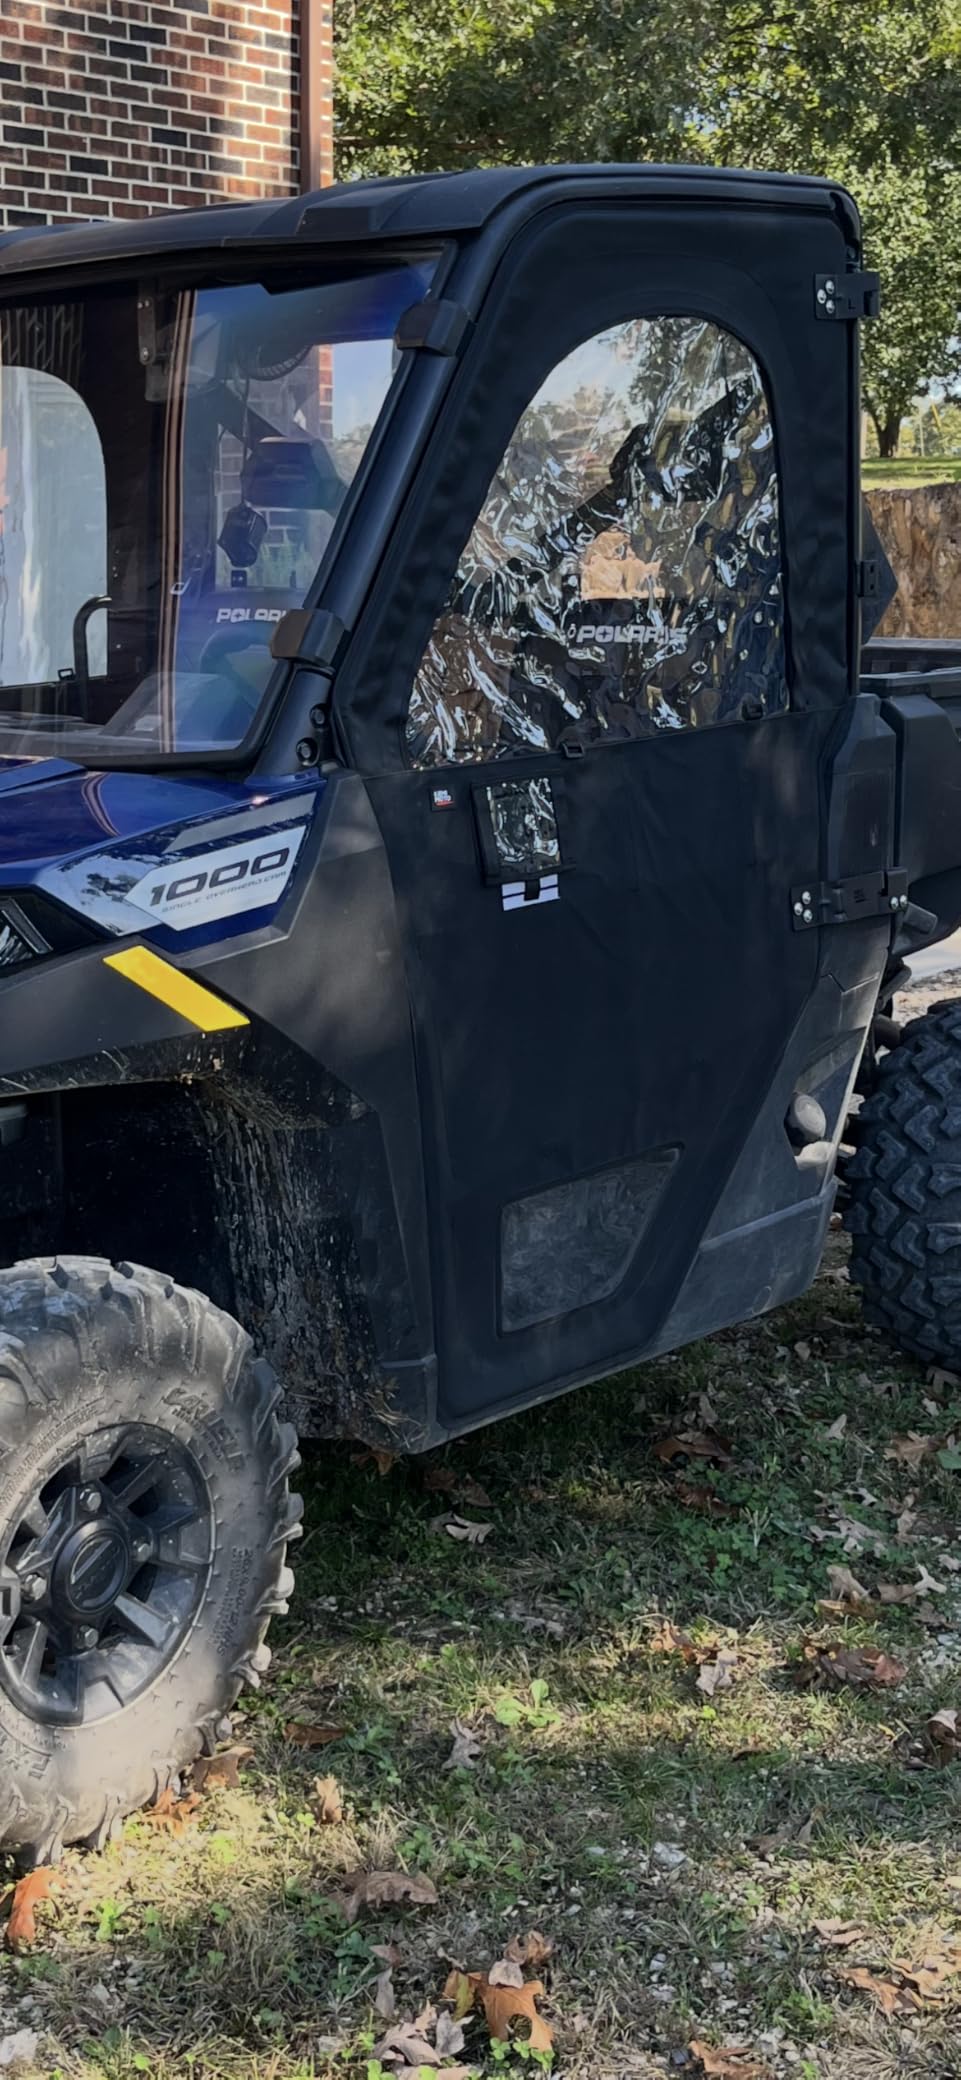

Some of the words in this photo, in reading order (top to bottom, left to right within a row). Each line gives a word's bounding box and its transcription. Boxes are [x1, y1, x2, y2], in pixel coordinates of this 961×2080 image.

[216, 608, 287, 623] POLAR
[576, 625, 689, 644] POLARIS
[150, 847, 290, 907] 1000
